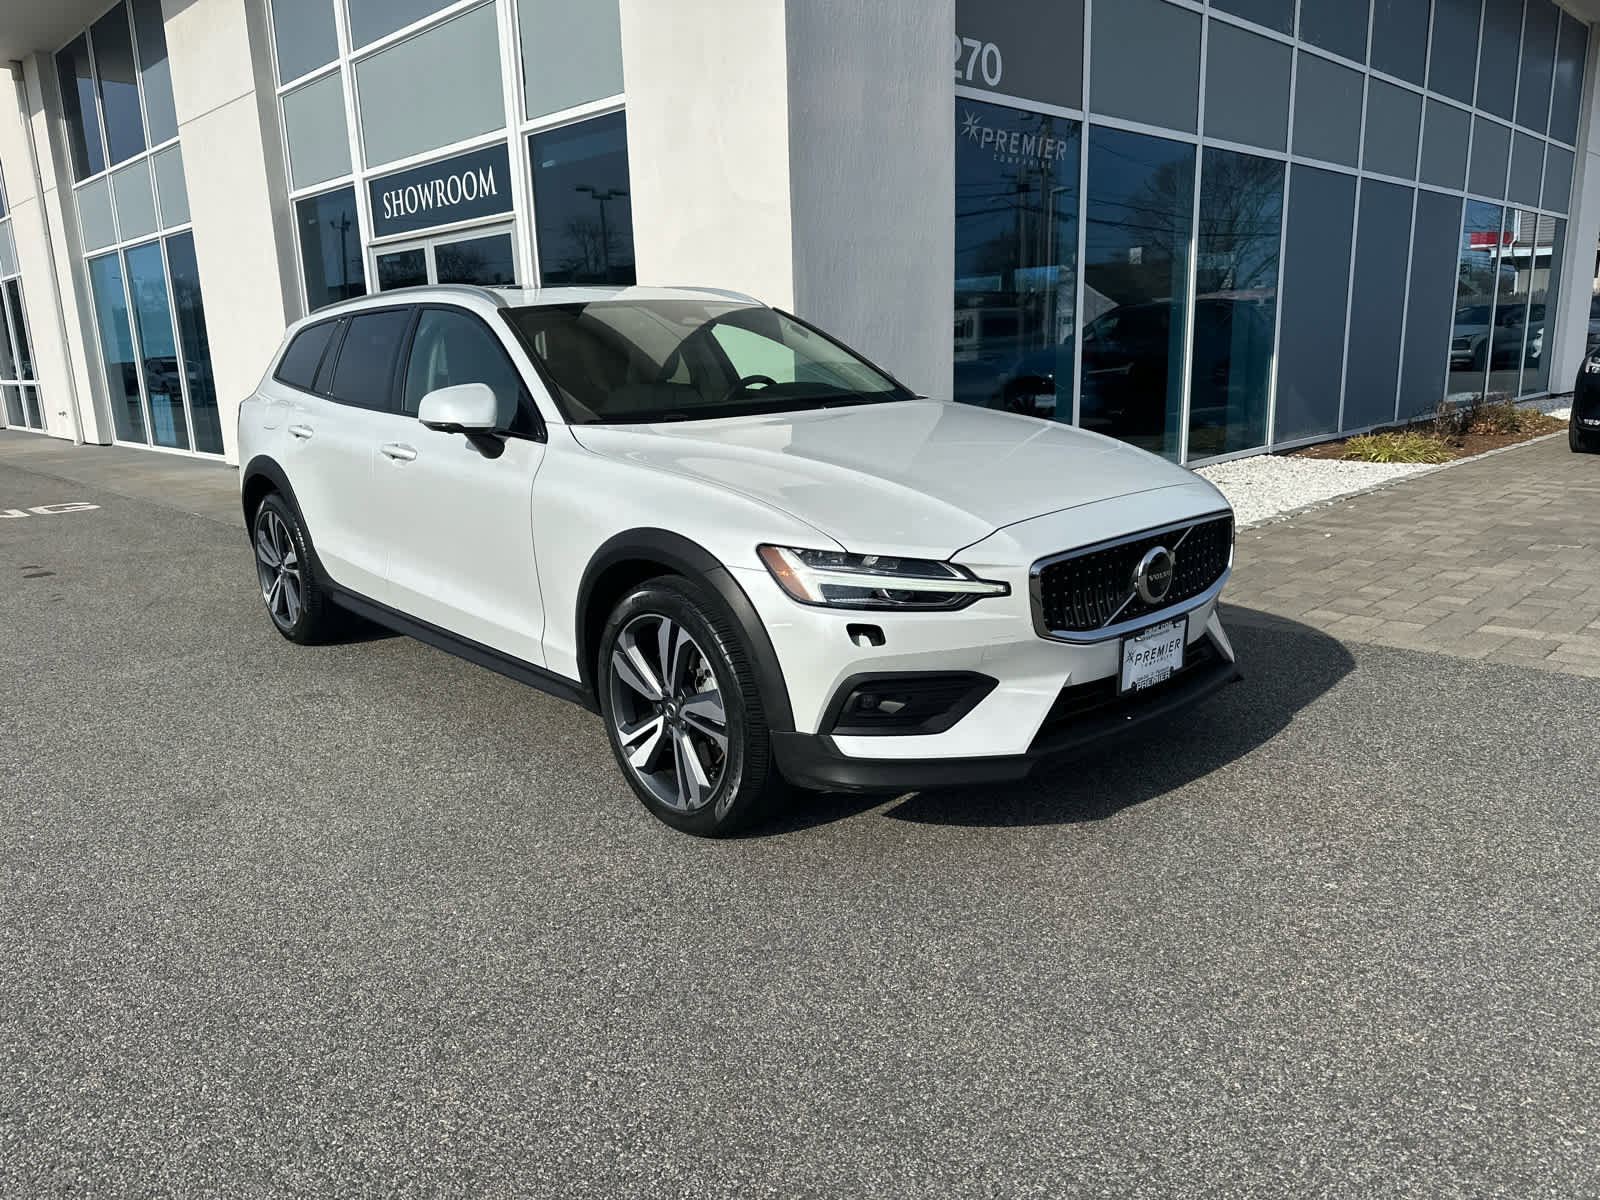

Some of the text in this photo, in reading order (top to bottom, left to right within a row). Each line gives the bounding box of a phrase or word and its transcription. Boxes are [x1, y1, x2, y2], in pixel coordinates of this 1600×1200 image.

[980, 127, 1067, 161] PREMIER
[383, 164, 498, 219] SHOWROOM
[1134, 638, 1181, 666] PREMIER
[1136, 670, 1170, 691] PREMIER
